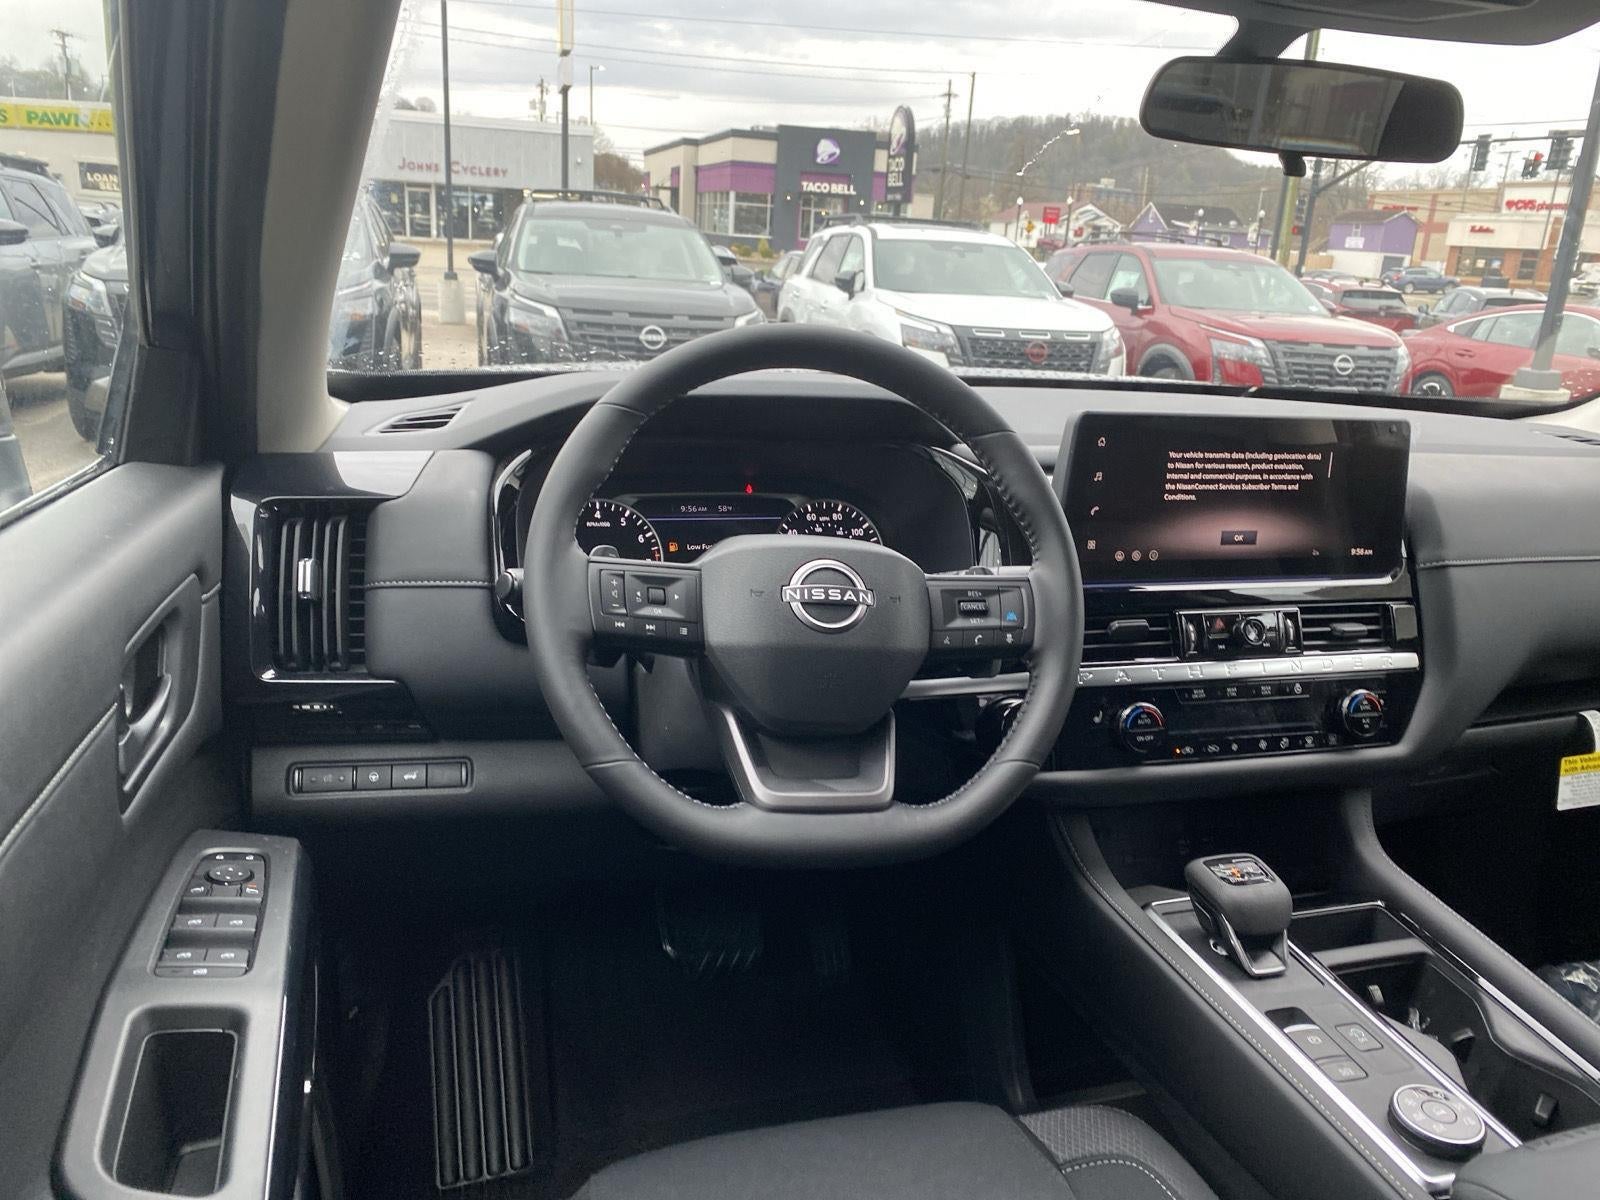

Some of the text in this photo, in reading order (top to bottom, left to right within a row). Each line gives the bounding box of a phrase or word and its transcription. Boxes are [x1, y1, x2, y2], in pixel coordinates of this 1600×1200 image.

[889, 157, 905, 173] TACO
[888, 172, 904, 187] BELL
[99, 181, 120, 191] SEL
[801, 181, 857, 196] TACO BELL
[1516, 199, 1537, 211] CVS
[1168, 451, 1183, 459] Your
[1183, 451, 1204, 459] vehicle
[1231, 451, 1245, 459] data
[1273, 452, 1307, 461] geolocation
[1306, 452, 1322, 461] data)
[1175, 462, 1195, 470] Nissan
[1195, 461, 1205, 470] for
[1251, 462, 1274, 471] product
[1190, 472, 1202, 480] and
[1165, 483, 1176, 491] the
[594, 510, 602, 519] 4
[806, 513, 817, 521] 60
[832, 513, 843, 521] 80
[620, 517, 627, 527] 5
[851, 528, 865, 537] 100
[637, 534, 645, 544] 6
[1233, 534, 1245, 542] OK
[687, 543, 701, 551] Low
[785, 587, 873, 604] NISSAN
[1077, 655, 1394, 686] PATHFINDER
